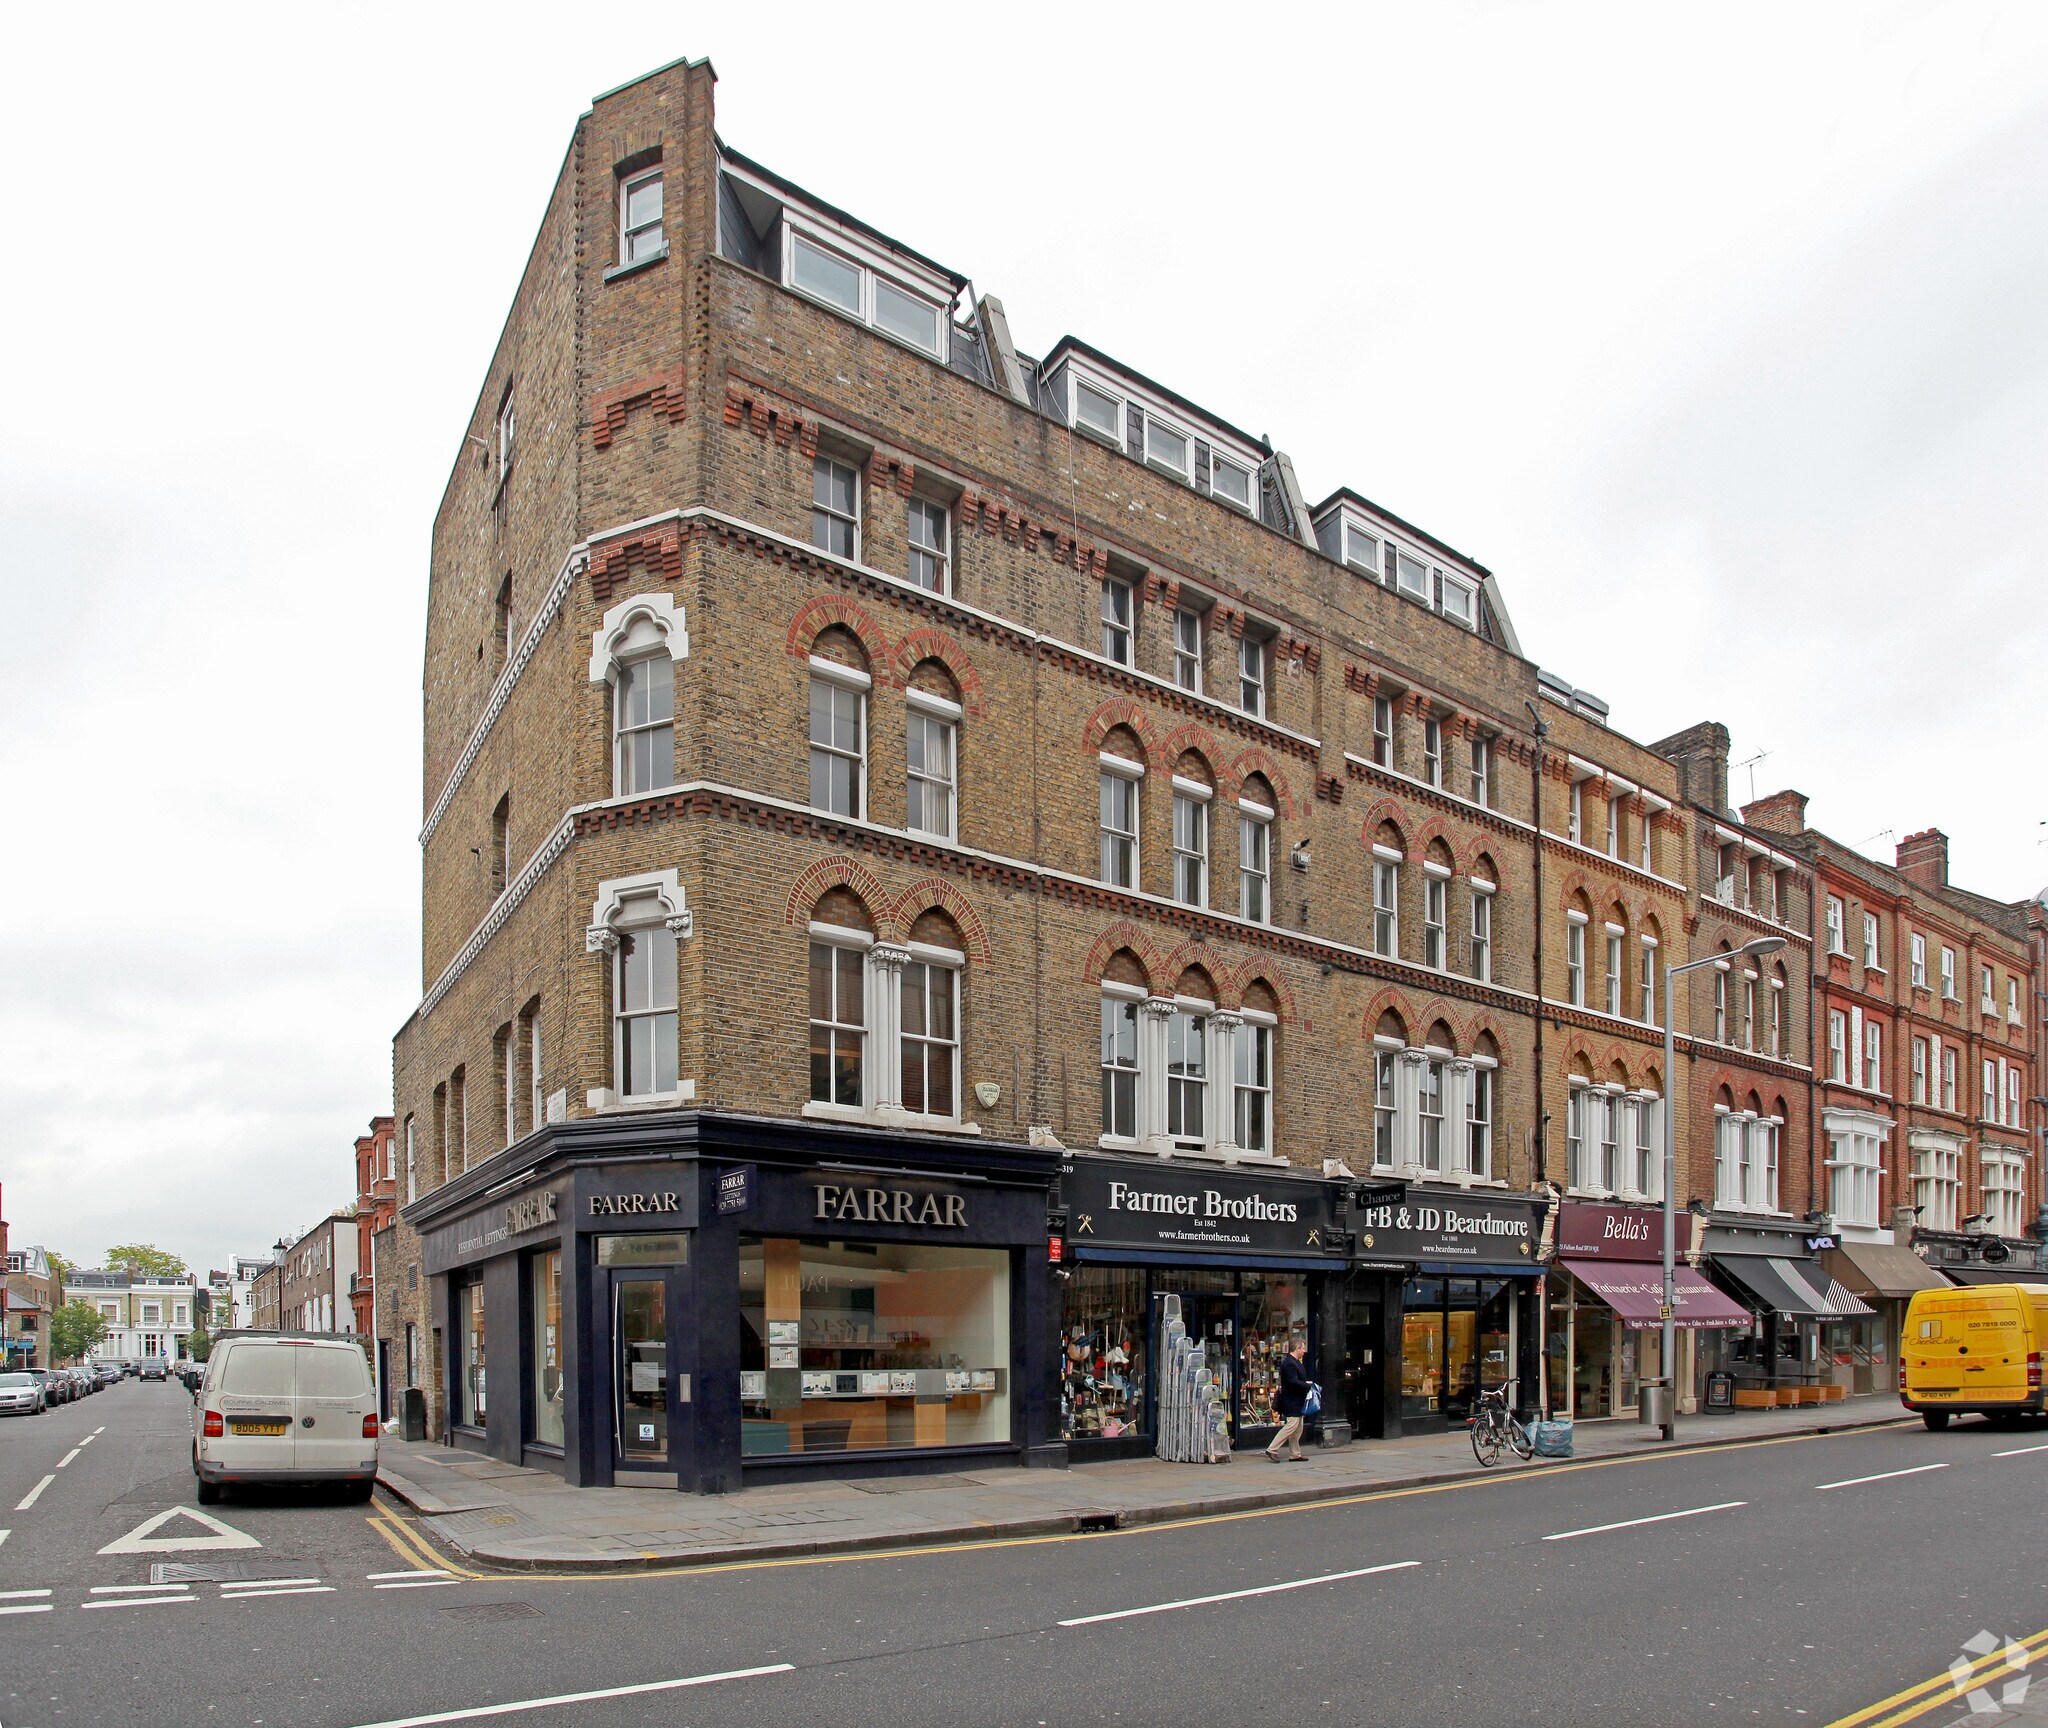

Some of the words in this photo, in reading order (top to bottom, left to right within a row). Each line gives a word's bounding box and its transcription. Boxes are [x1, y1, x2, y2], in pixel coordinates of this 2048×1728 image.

[1062, 1165, 1074, 1173] 319
[722, 1175, 745, 1190] FARRAR
[588, 1192, 679, 1215] FARRAR
[1108, 1182, 1198, 1215] Farmer
[1203, 1190, 1298, 1222] Brothers
[1360, 1192, 1401, 1205] Chance
[813, 1184, 969, 1227] FARRAR
[506, 1191, 557, 1236] FARRAR
[1194, 1219, 1203, 1227] Est
[1204, 1219, 1217, 1228] 1842
[1365, 1206, 1392, 1228] FB
[1396, 1207, 1412, 1230] &
[1415, 1208, 1440, 1231] JD
[1444, 1209, 1529, 1236] Beardmore
[1603, 1215, 1649, 1240] Bella's
[458, 1235, 483, 1254] RESIDENTIAL
[484, 1226, 507, 1246] LETTINGS
[1158, 1230, 1250, 1243] www.farmerbrothers.co.uk
[1807, 1237, 1835, 1249] VQ
[1422, 1245, 1478, 1254] www.beardmore.co.uk
[1589, 1282, 1641, 1294] Patisserie
[1674, 1285, 1715, 1294] estaurant
[1661, 1307, 1670, 1317] H
[1917, 1298, 2004, 1313] cheese
[1948, 1311, 1993, 1320] olives
[1975, 1332, 2014, 1344] pesto
[1914, 1357, 1994, 1369] sauces
[236, 1424, 260, 1433] BD05
[263, 1424, 281, 1433] YTT
